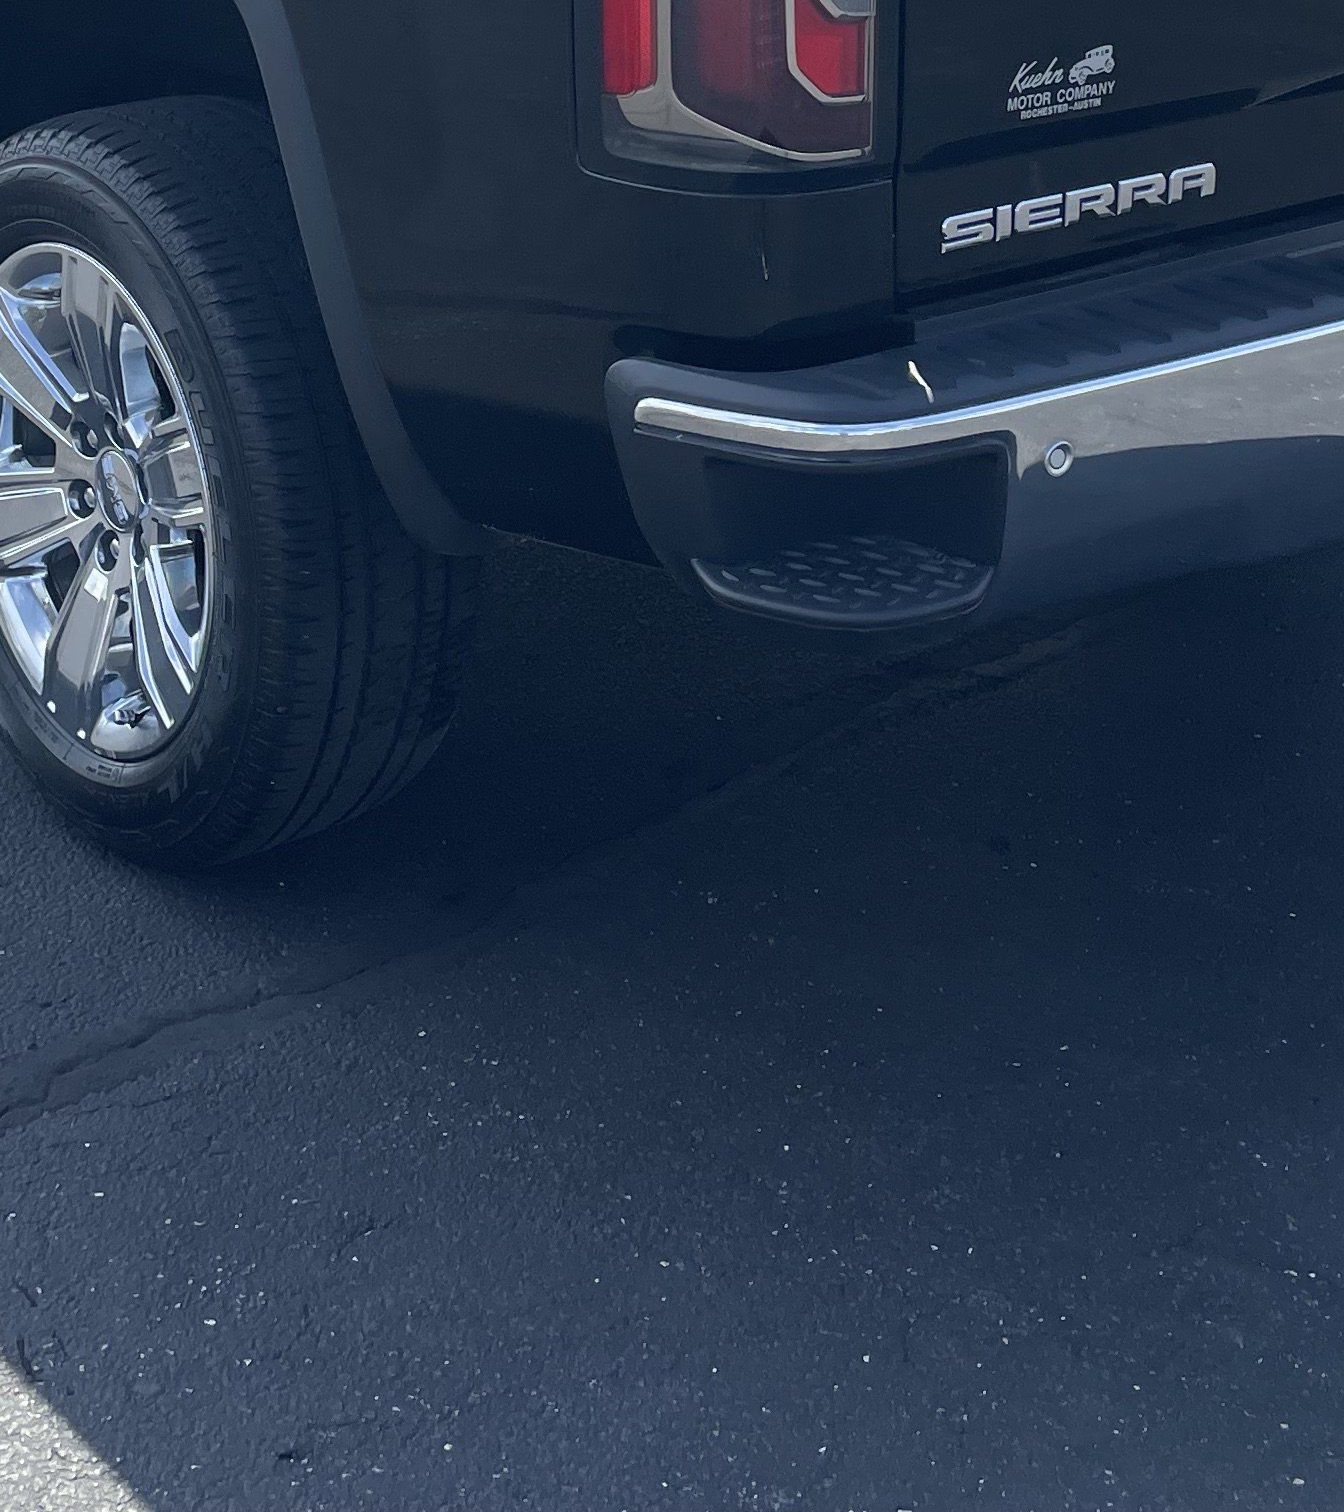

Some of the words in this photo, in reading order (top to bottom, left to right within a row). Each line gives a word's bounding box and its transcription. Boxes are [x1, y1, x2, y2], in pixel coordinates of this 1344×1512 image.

[1009, 57, 1063, 93] Kuehn
[1007, 92, 1051, 111] MOTOR
[1056, 80, 1115, 102] COMPANY
[941, 163, 1216, 254] SIERRA
